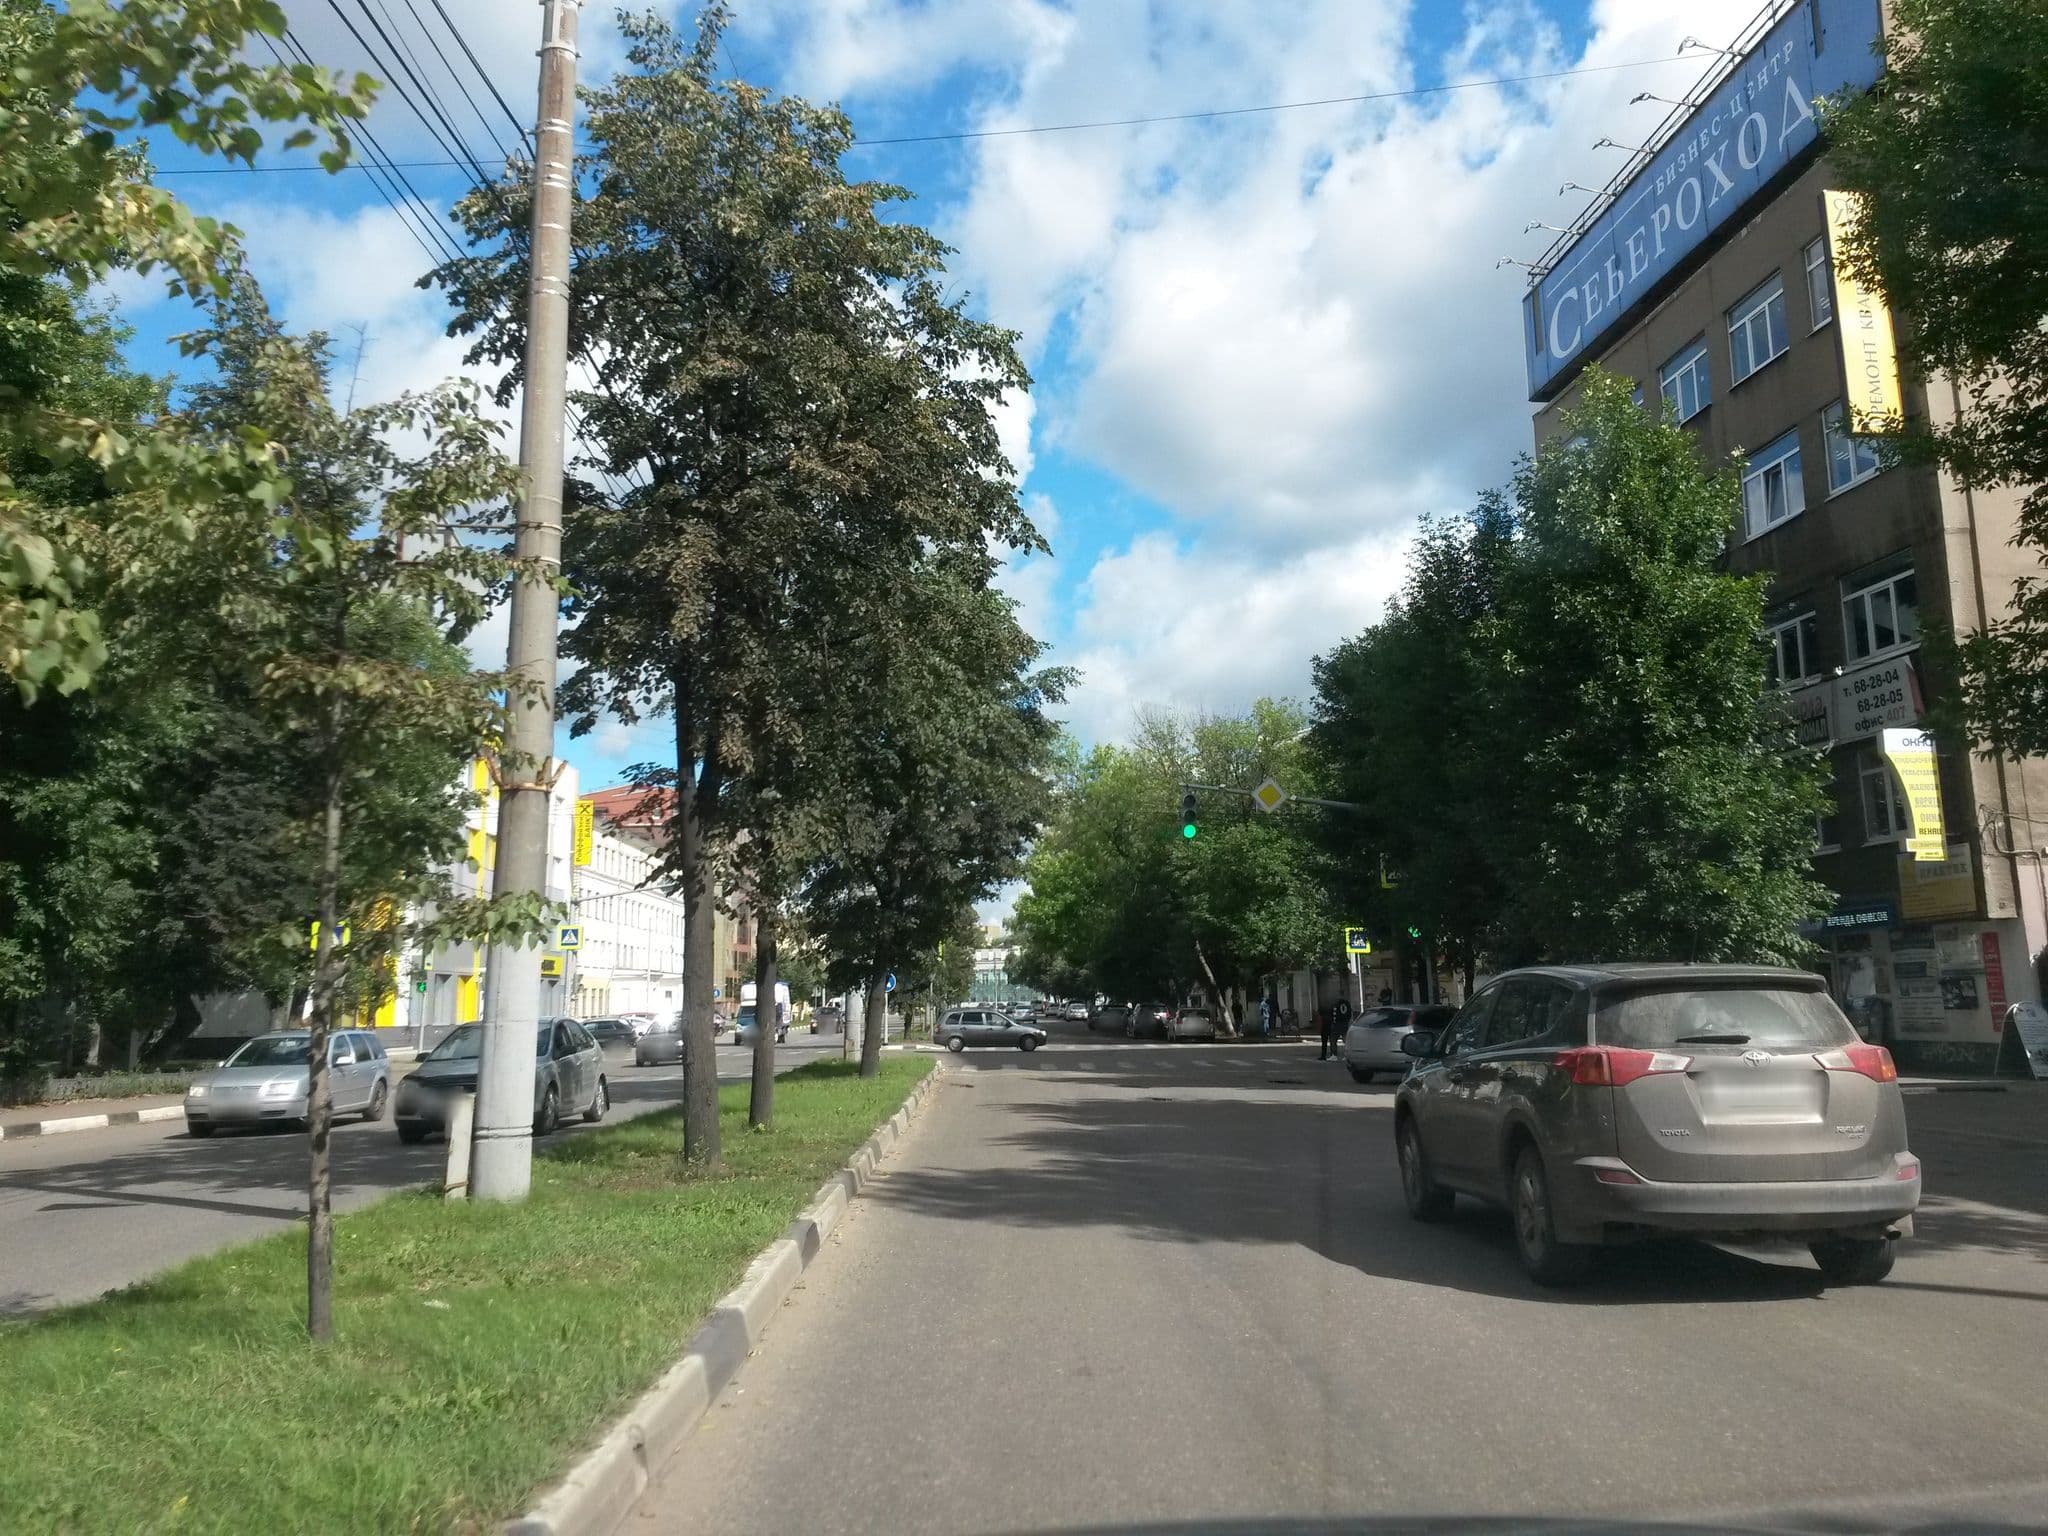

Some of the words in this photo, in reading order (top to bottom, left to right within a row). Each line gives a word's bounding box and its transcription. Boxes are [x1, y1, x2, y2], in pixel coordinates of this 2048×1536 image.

[1656, 40, 1794, 195] БИЗНЕС-ЦЕНТР
[1862, 339, 1884, 415] РЕМОНТ
[1853, 668, 1899, 694] 68-28-04
[1857, 688, 1903, 713] 68-28-05
[1855, 714, 1884, 732] офис
[1886, 705, 1906, 721] 407
